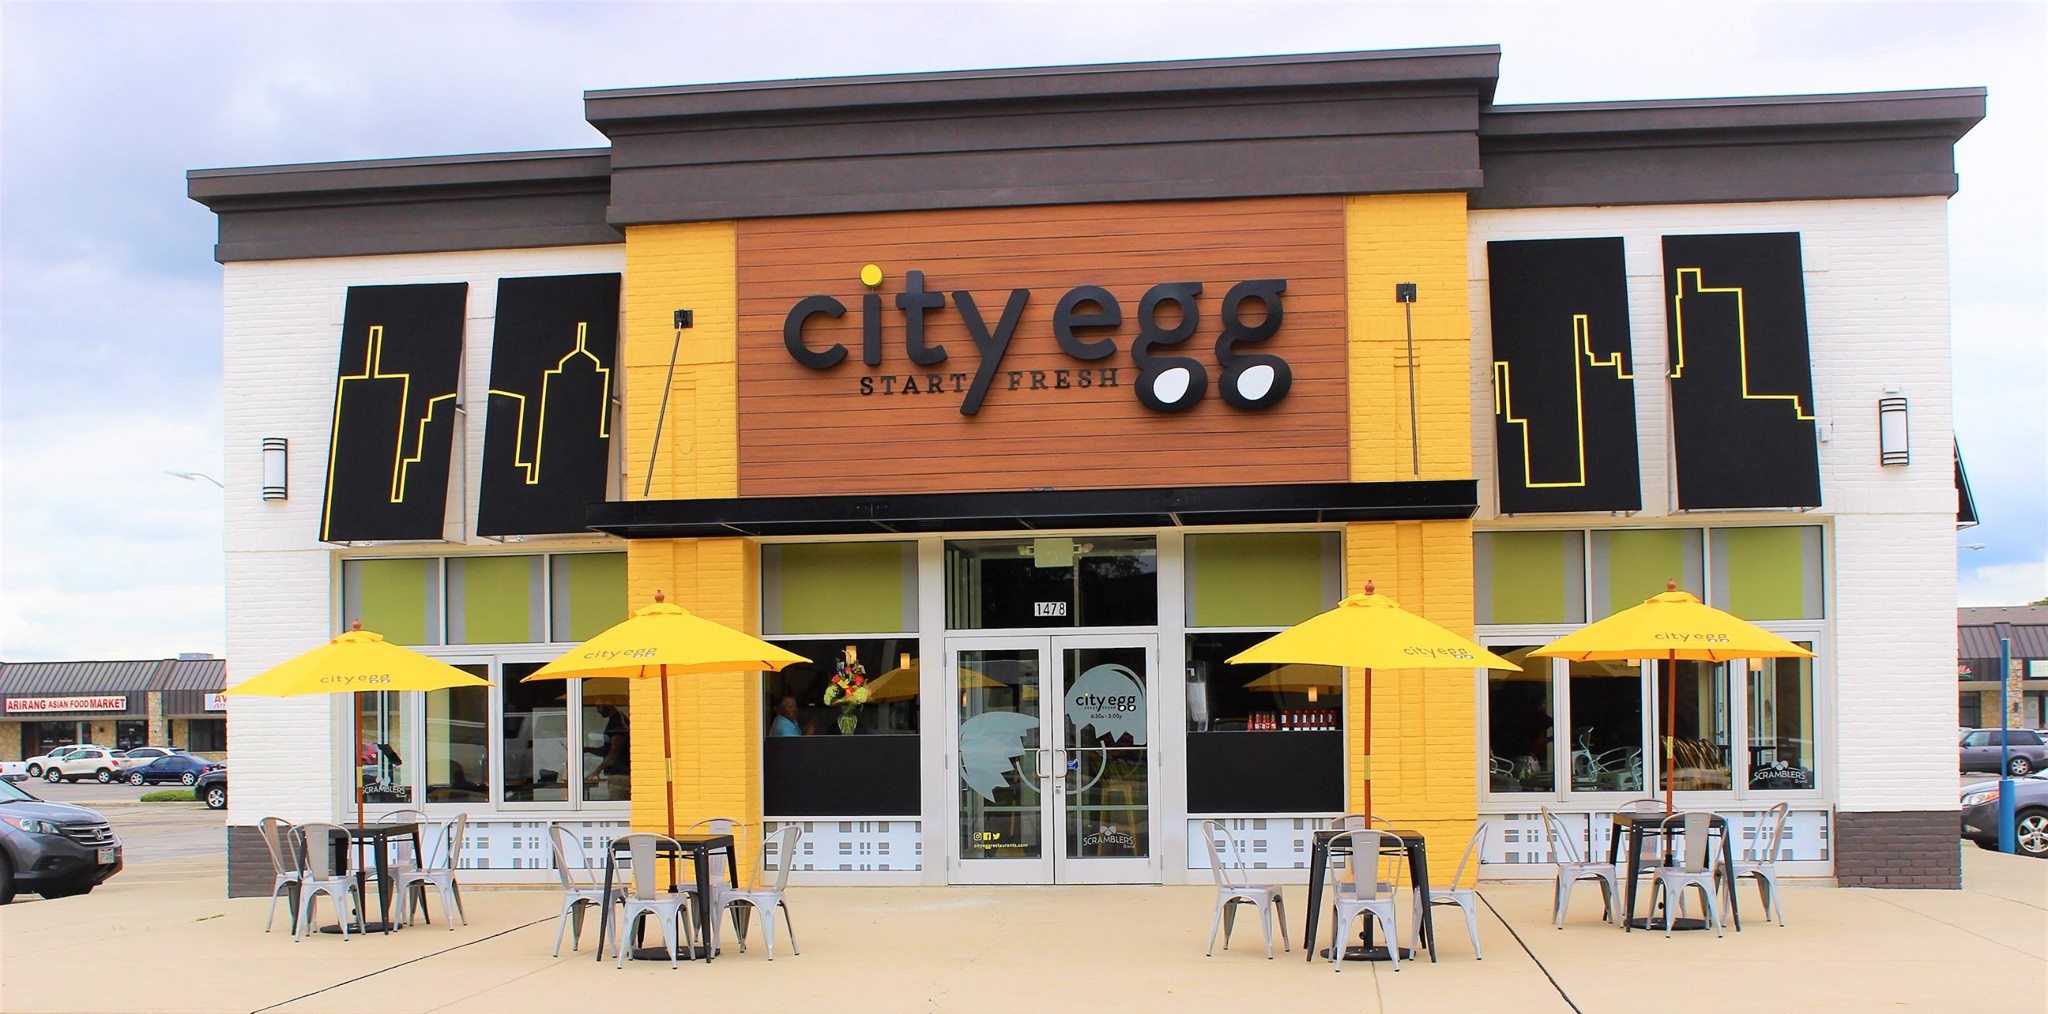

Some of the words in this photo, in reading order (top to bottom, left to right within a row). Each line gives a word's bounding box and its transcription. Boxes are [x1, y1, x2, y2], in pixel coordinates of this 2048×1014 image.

[783, 263, 1030, 415] city
[1053, 279, 1292, 412] egg
[860, 373, 967, 395] START
[1008, 368, 1118, 390] FRESH
[1037, 602, 1065, 615] 1478
[1655, 632, 1689, 642] city
[1694, 633, 1730, 643] egg
[584, 650, 621, 661] city
[624, 648, 658, 658] egg
[1404, 646, 1436, 658] city
[1437, 648, 1474, 659] egg
[320, 674, 354, 685] city
[358, 674, 391, 684] egg
[8, 700, 46, 710] ARIRANG
[48, 700, 68, 709] ASIAN
[70, 700, 89, 708] FOOD
[90, 698, 126, 709] MARKET
[1076, 692, 1106, 712] city
[1108, 696, 1136, 712] egg
[1754, 770, 1806, 780] SCRAMBLERS
[1083, 836, 1134, 846] SCRAMBLERS
